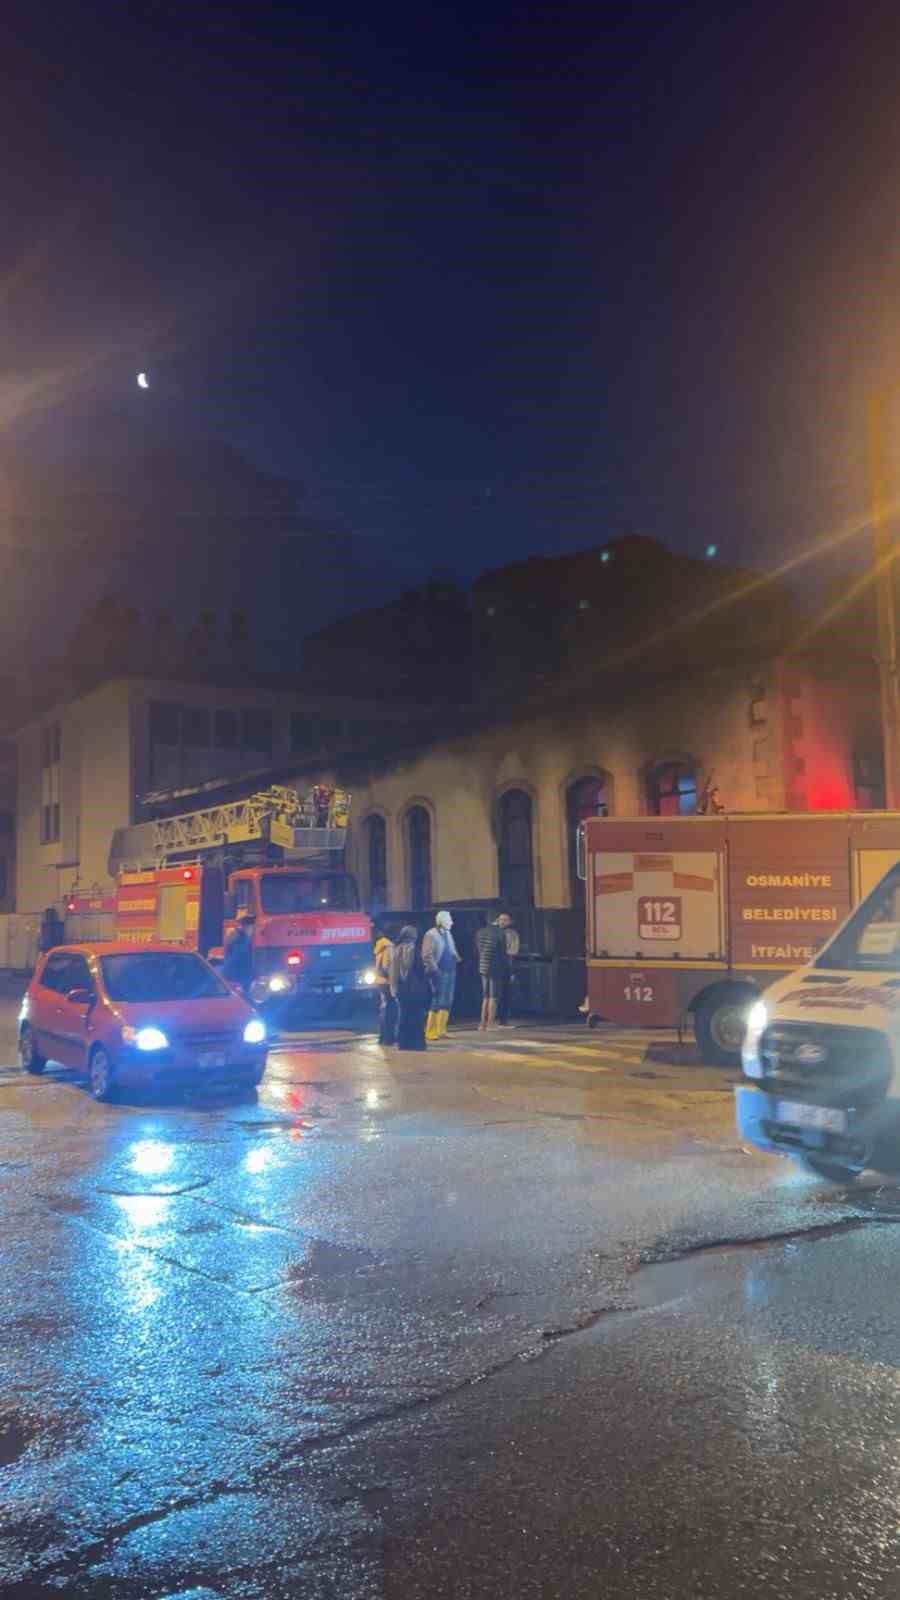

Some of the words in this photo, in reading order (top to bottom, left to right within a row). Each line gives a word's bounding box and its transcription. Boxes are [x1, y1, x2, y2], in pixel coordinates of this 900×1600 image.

[746, 873, 832, 886] OSMANİYE
[644, 902, 675, 921] 112
[743, 907, 837, 920] BELEDİYESİ
[624, 986, 653, 1001] 112
